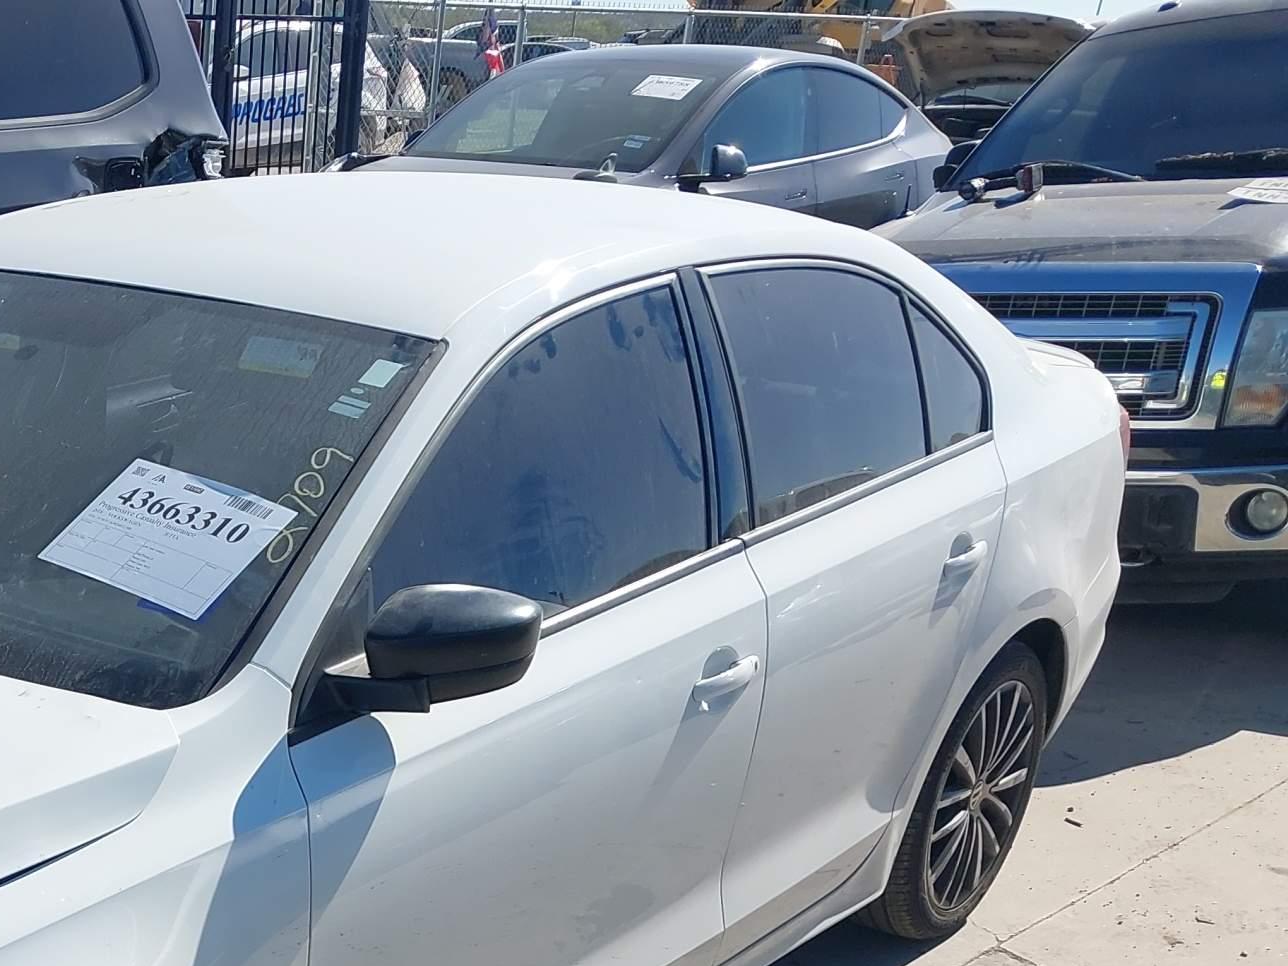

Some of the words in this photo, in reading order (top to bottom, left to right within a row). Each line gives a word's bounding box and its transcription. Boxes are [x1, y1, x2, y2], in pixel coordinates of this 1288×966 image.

[98, 500, 135, 518] Progressive
[135, 511, 163, 528] Casualty
[163, 519, 198, 539] Insurance
[117, 486, 250, 544] 43663310
